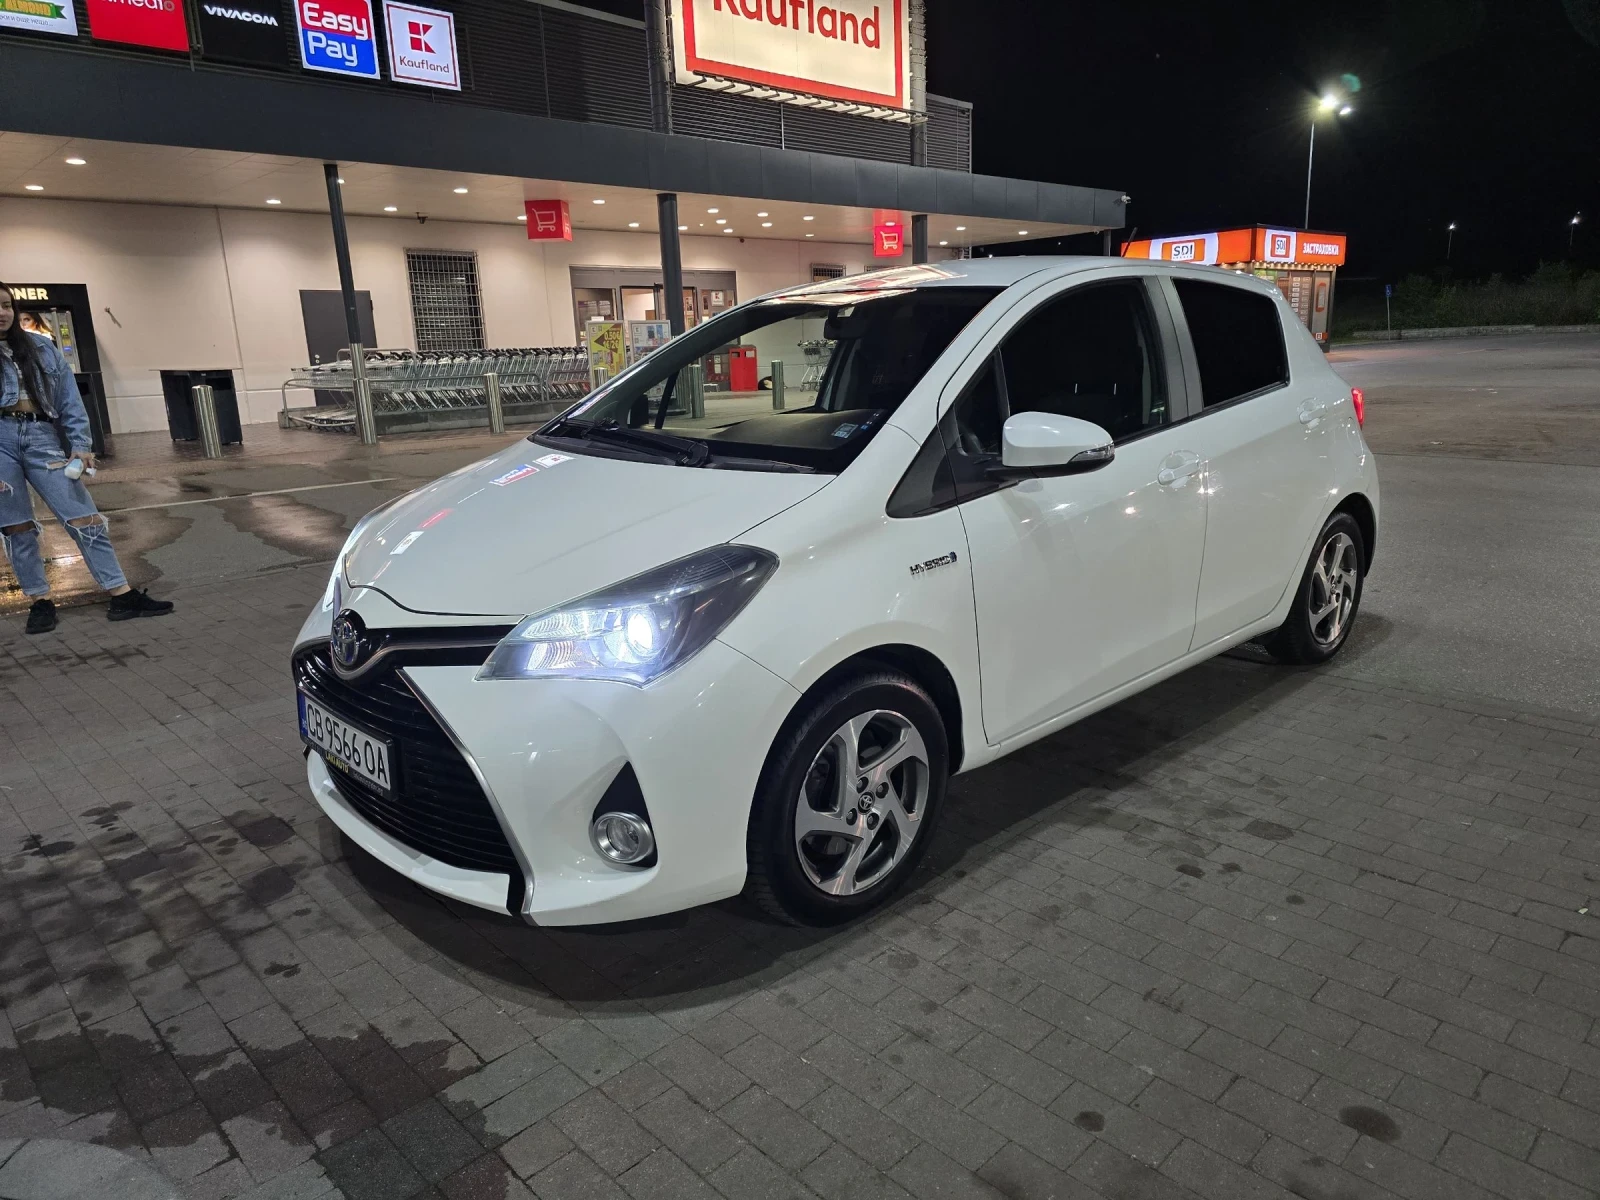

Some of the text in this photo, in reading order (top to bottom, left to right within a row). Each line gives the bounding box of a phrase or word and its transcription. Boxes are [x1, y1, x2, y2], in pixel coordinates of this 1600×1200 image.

[204, 5, 278, 26] VIVACOM
[303, 2, 368, 41] Easy
[307, 31, 358, 67] Pay
[399, 56, 450, 74] Kaufland
[1173, 244, 1194, 257] SDI
